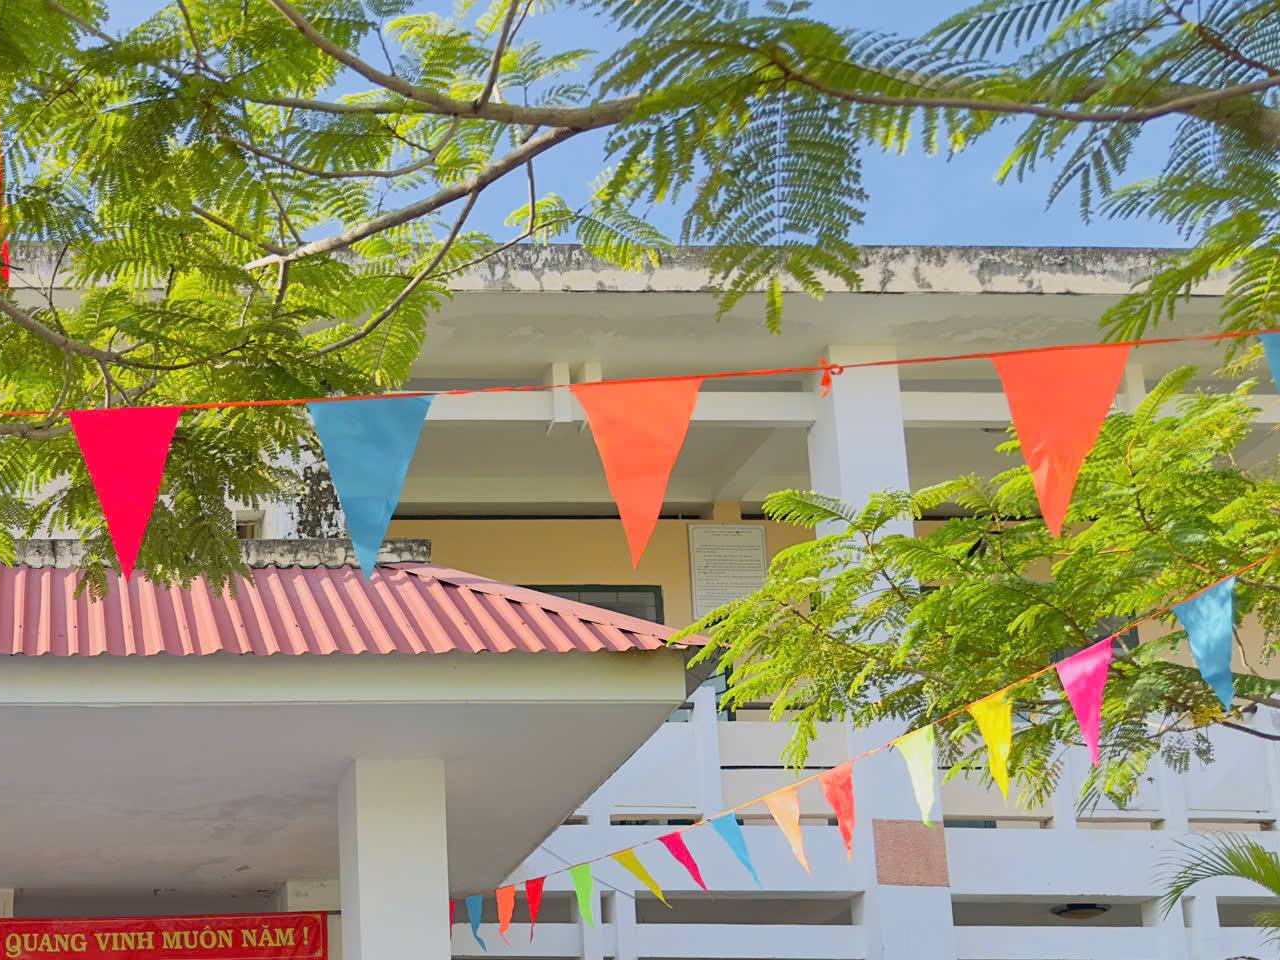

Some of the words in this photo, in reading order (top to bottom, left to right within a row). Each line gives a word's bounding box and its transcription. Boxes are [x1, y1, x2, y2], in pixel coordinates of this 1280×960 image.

[6, 932, 88, 958] QUANG
[95, 930, 157, 951] VINH
[162, 925, 233, 949] MUÔN
[241, 923, 296, 947] NĂM
[302, 927, 310, 945] !
